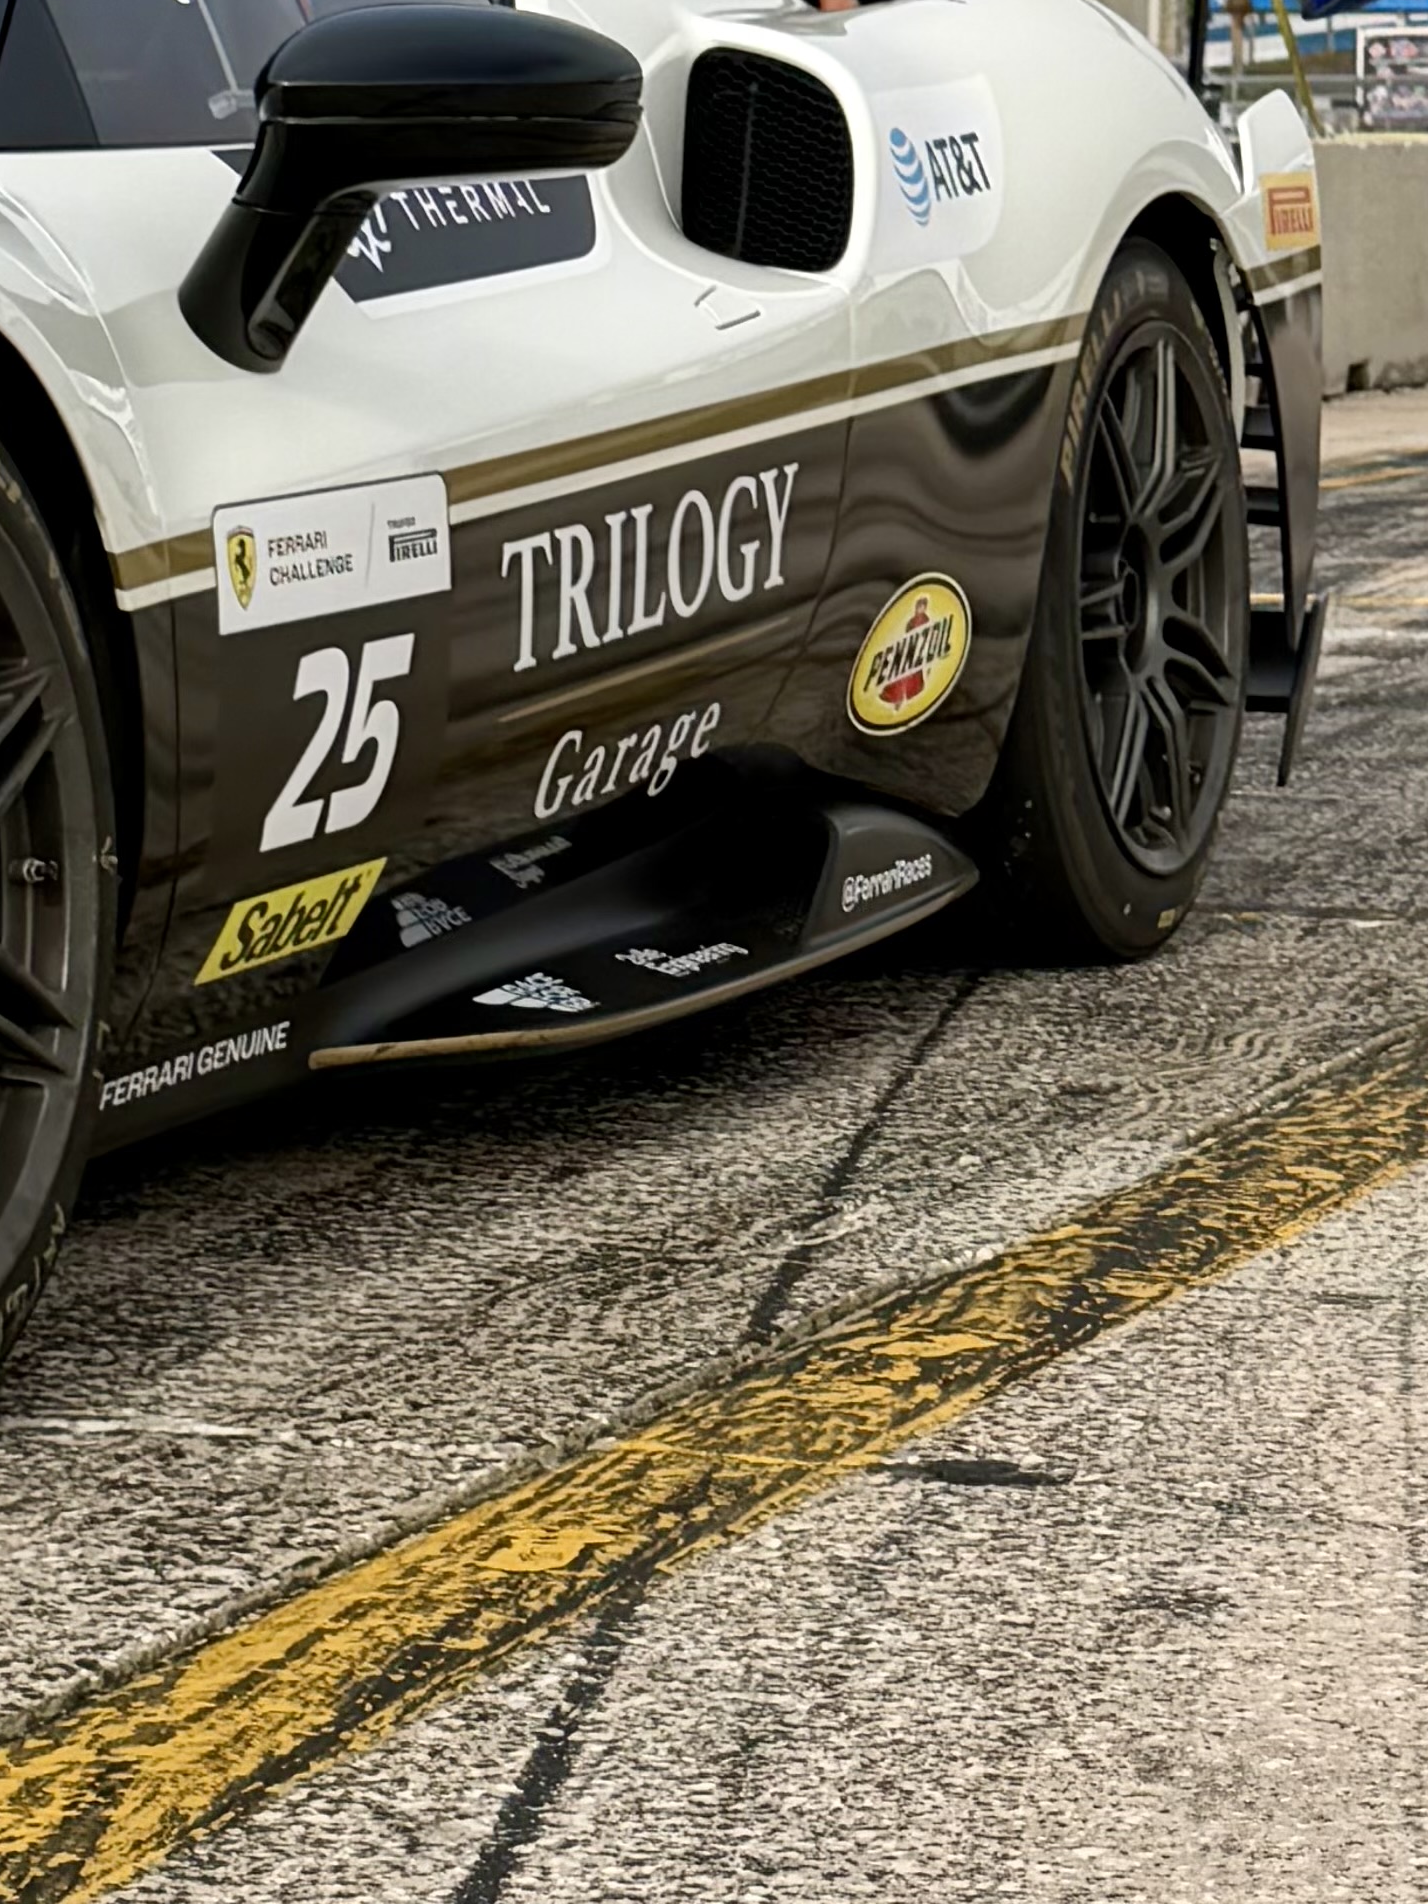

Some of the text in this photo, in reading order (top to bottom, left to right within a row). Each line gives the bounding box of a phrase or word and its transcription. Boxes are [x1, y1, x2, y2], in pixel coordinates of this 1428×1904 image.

[925, 131, 991, 202] AT&T
[1267, 185, 1314, 236] PIRELLI
[268, 530, 328, 559] FERRARI
[269, 553, 354, 587] CHALLENGE
[388, 528, 439, 564] PIRELLI
[501, 462, 800, 673] TRILOGY
[863, 613, 955, 693] PENNZOIL
[259, 632, 416, 854] 25
[533, 700, 722, 821] Garage
[841, 853, 933, 913] @FerrariRaces
[219, 873, 363, 971] Sabelt
[99, 1020, 291, 1110] FERRARI GENUINE
